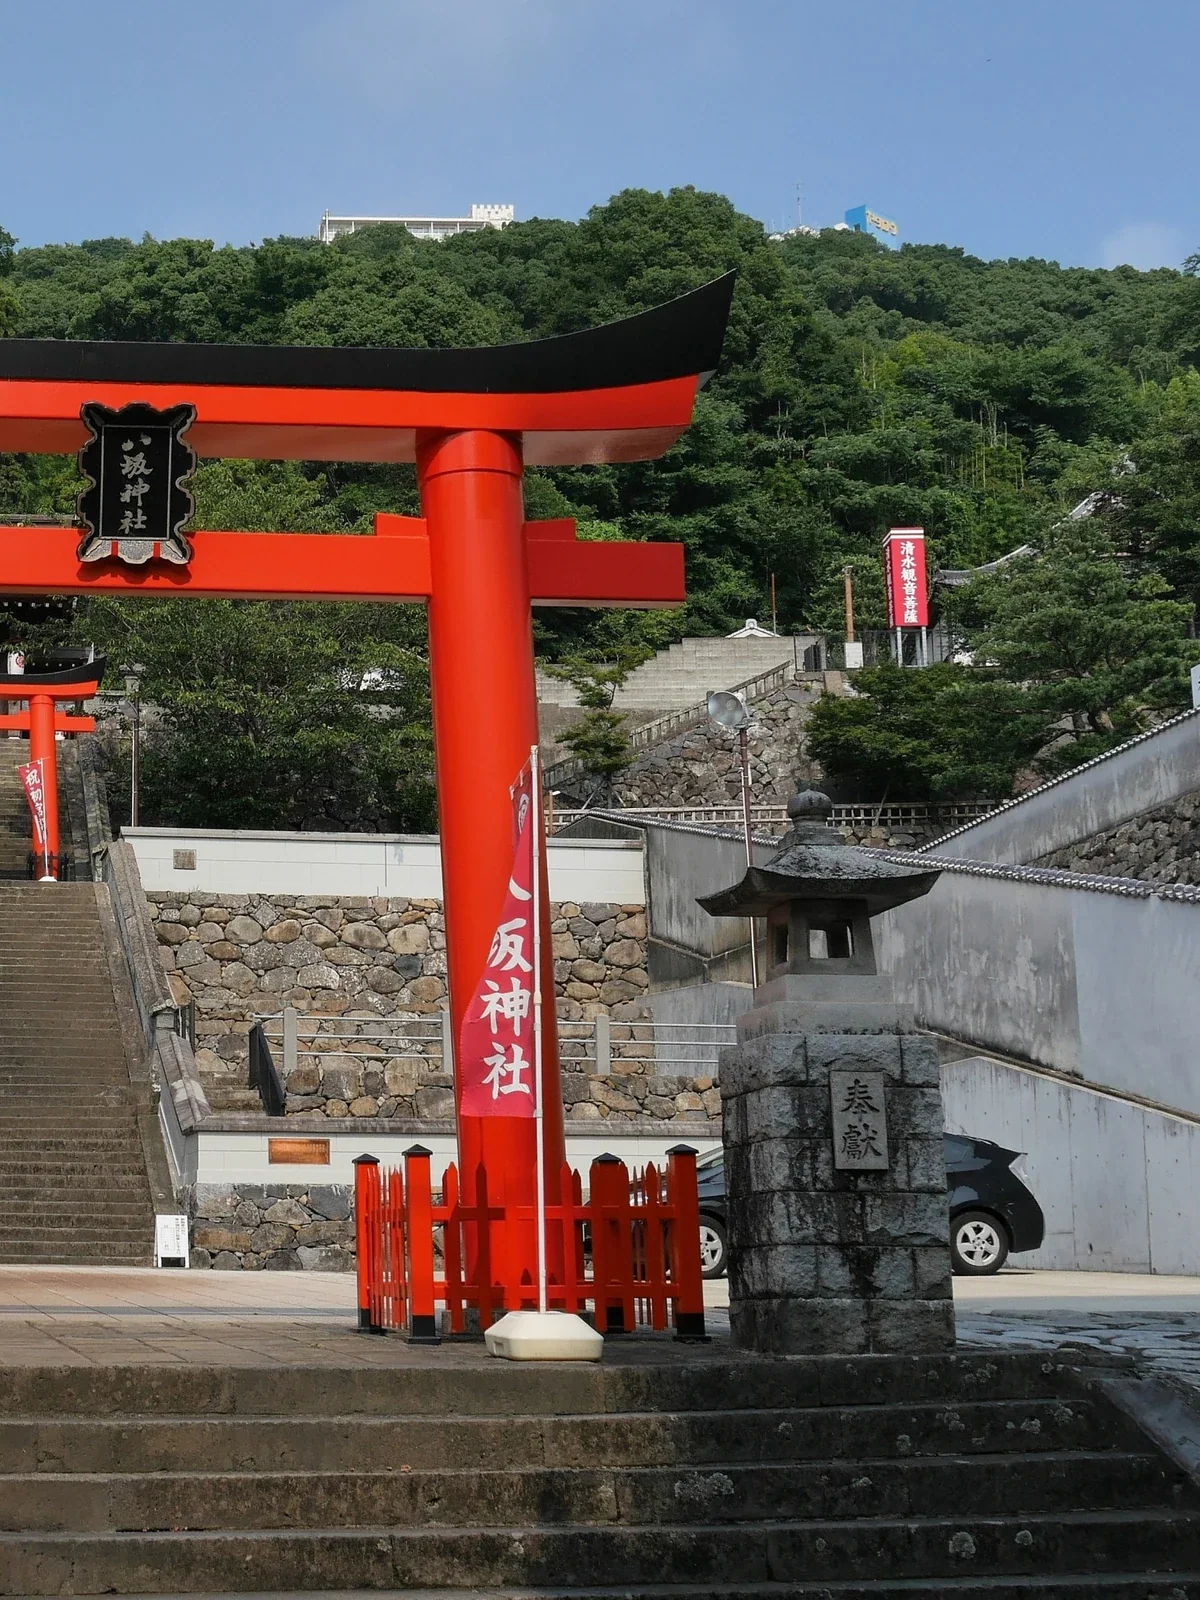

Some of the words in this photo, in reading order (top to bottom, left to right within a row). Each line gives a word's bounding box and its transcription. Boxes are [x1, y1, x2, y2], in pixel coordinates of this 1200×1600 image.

[118, 431, 154, 536] 八坂神社
[900, 541, 919, 624] 清水観音菩薩
